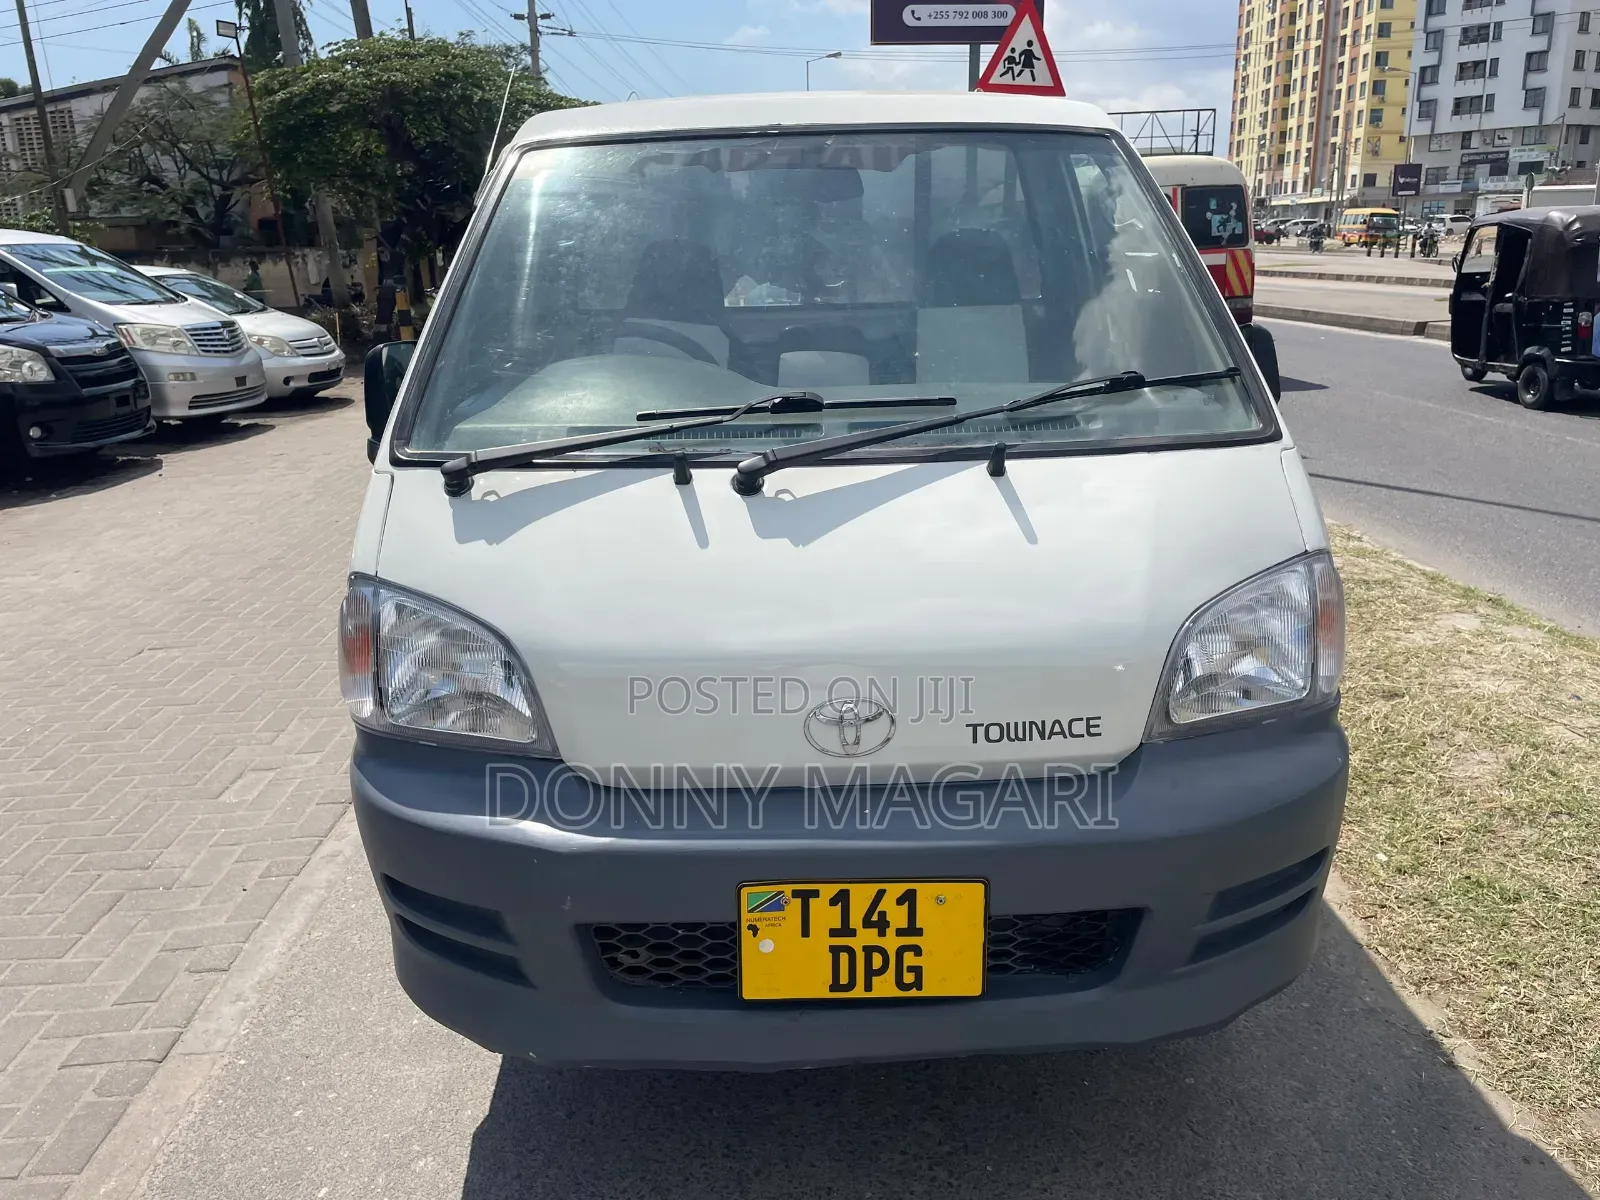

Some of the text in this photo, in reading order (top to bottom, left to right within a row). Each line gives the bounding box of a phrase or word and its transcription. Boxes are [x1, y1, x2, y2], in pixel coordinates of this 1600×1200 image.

[927, 10, 1008, 20] +255 792 008 300
[965, 715, 1103, 745] TOWNACE
[828, 944, 924, 992] DPG
